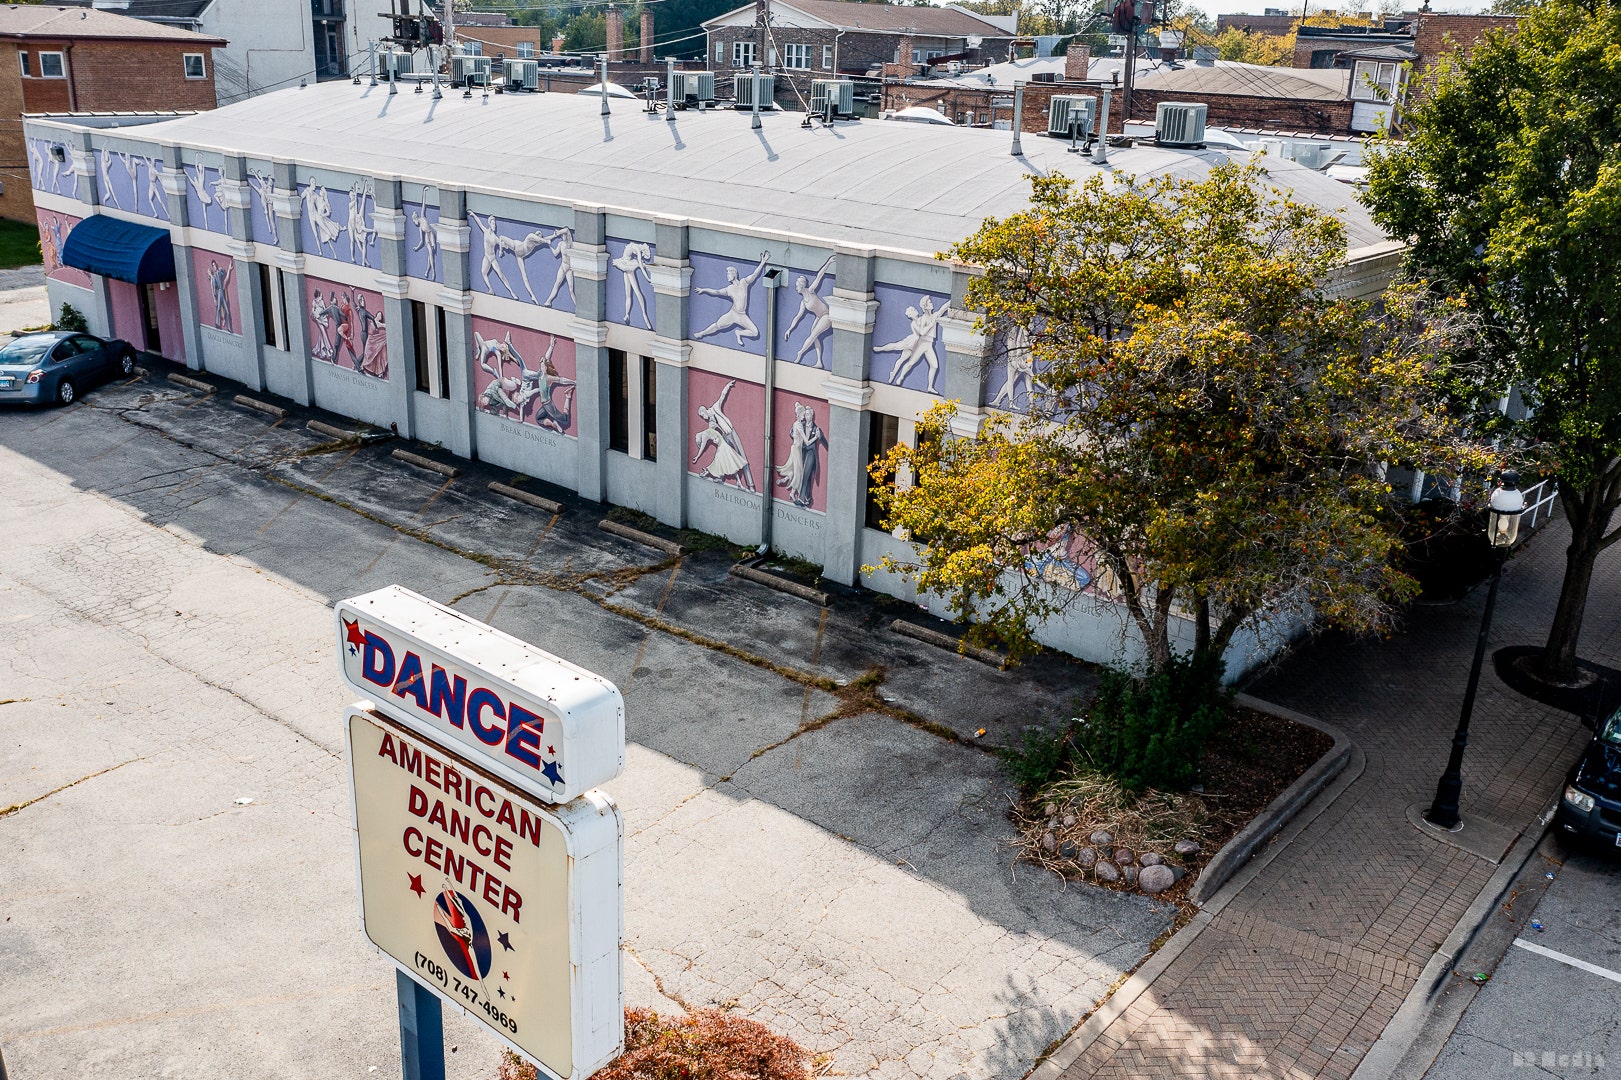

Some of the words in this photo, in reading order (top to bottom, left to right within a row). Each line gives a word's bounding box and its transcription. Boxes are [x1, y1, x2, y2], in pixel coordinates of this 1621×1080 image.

[328, 370, 350, 383] SPANISH
[352, 376, 378, 391] DANCERS
[500, 423, 522, 437] BREAK
[524, 430, 557, 448] DANCERS
[714, 488, 761, 512] BALLROOM
[777, 508, 820, 530] DANCERS
[362, 629, 544, 771] DANCE
[378, 731, 542, 848] AMERICAN
[408, 783, 513, 873] DANCE
[402, 826, 523, 924] CENTER
[414, 950, 448, 988] (708)
[453, 976, 518, 1034] 747-4969
